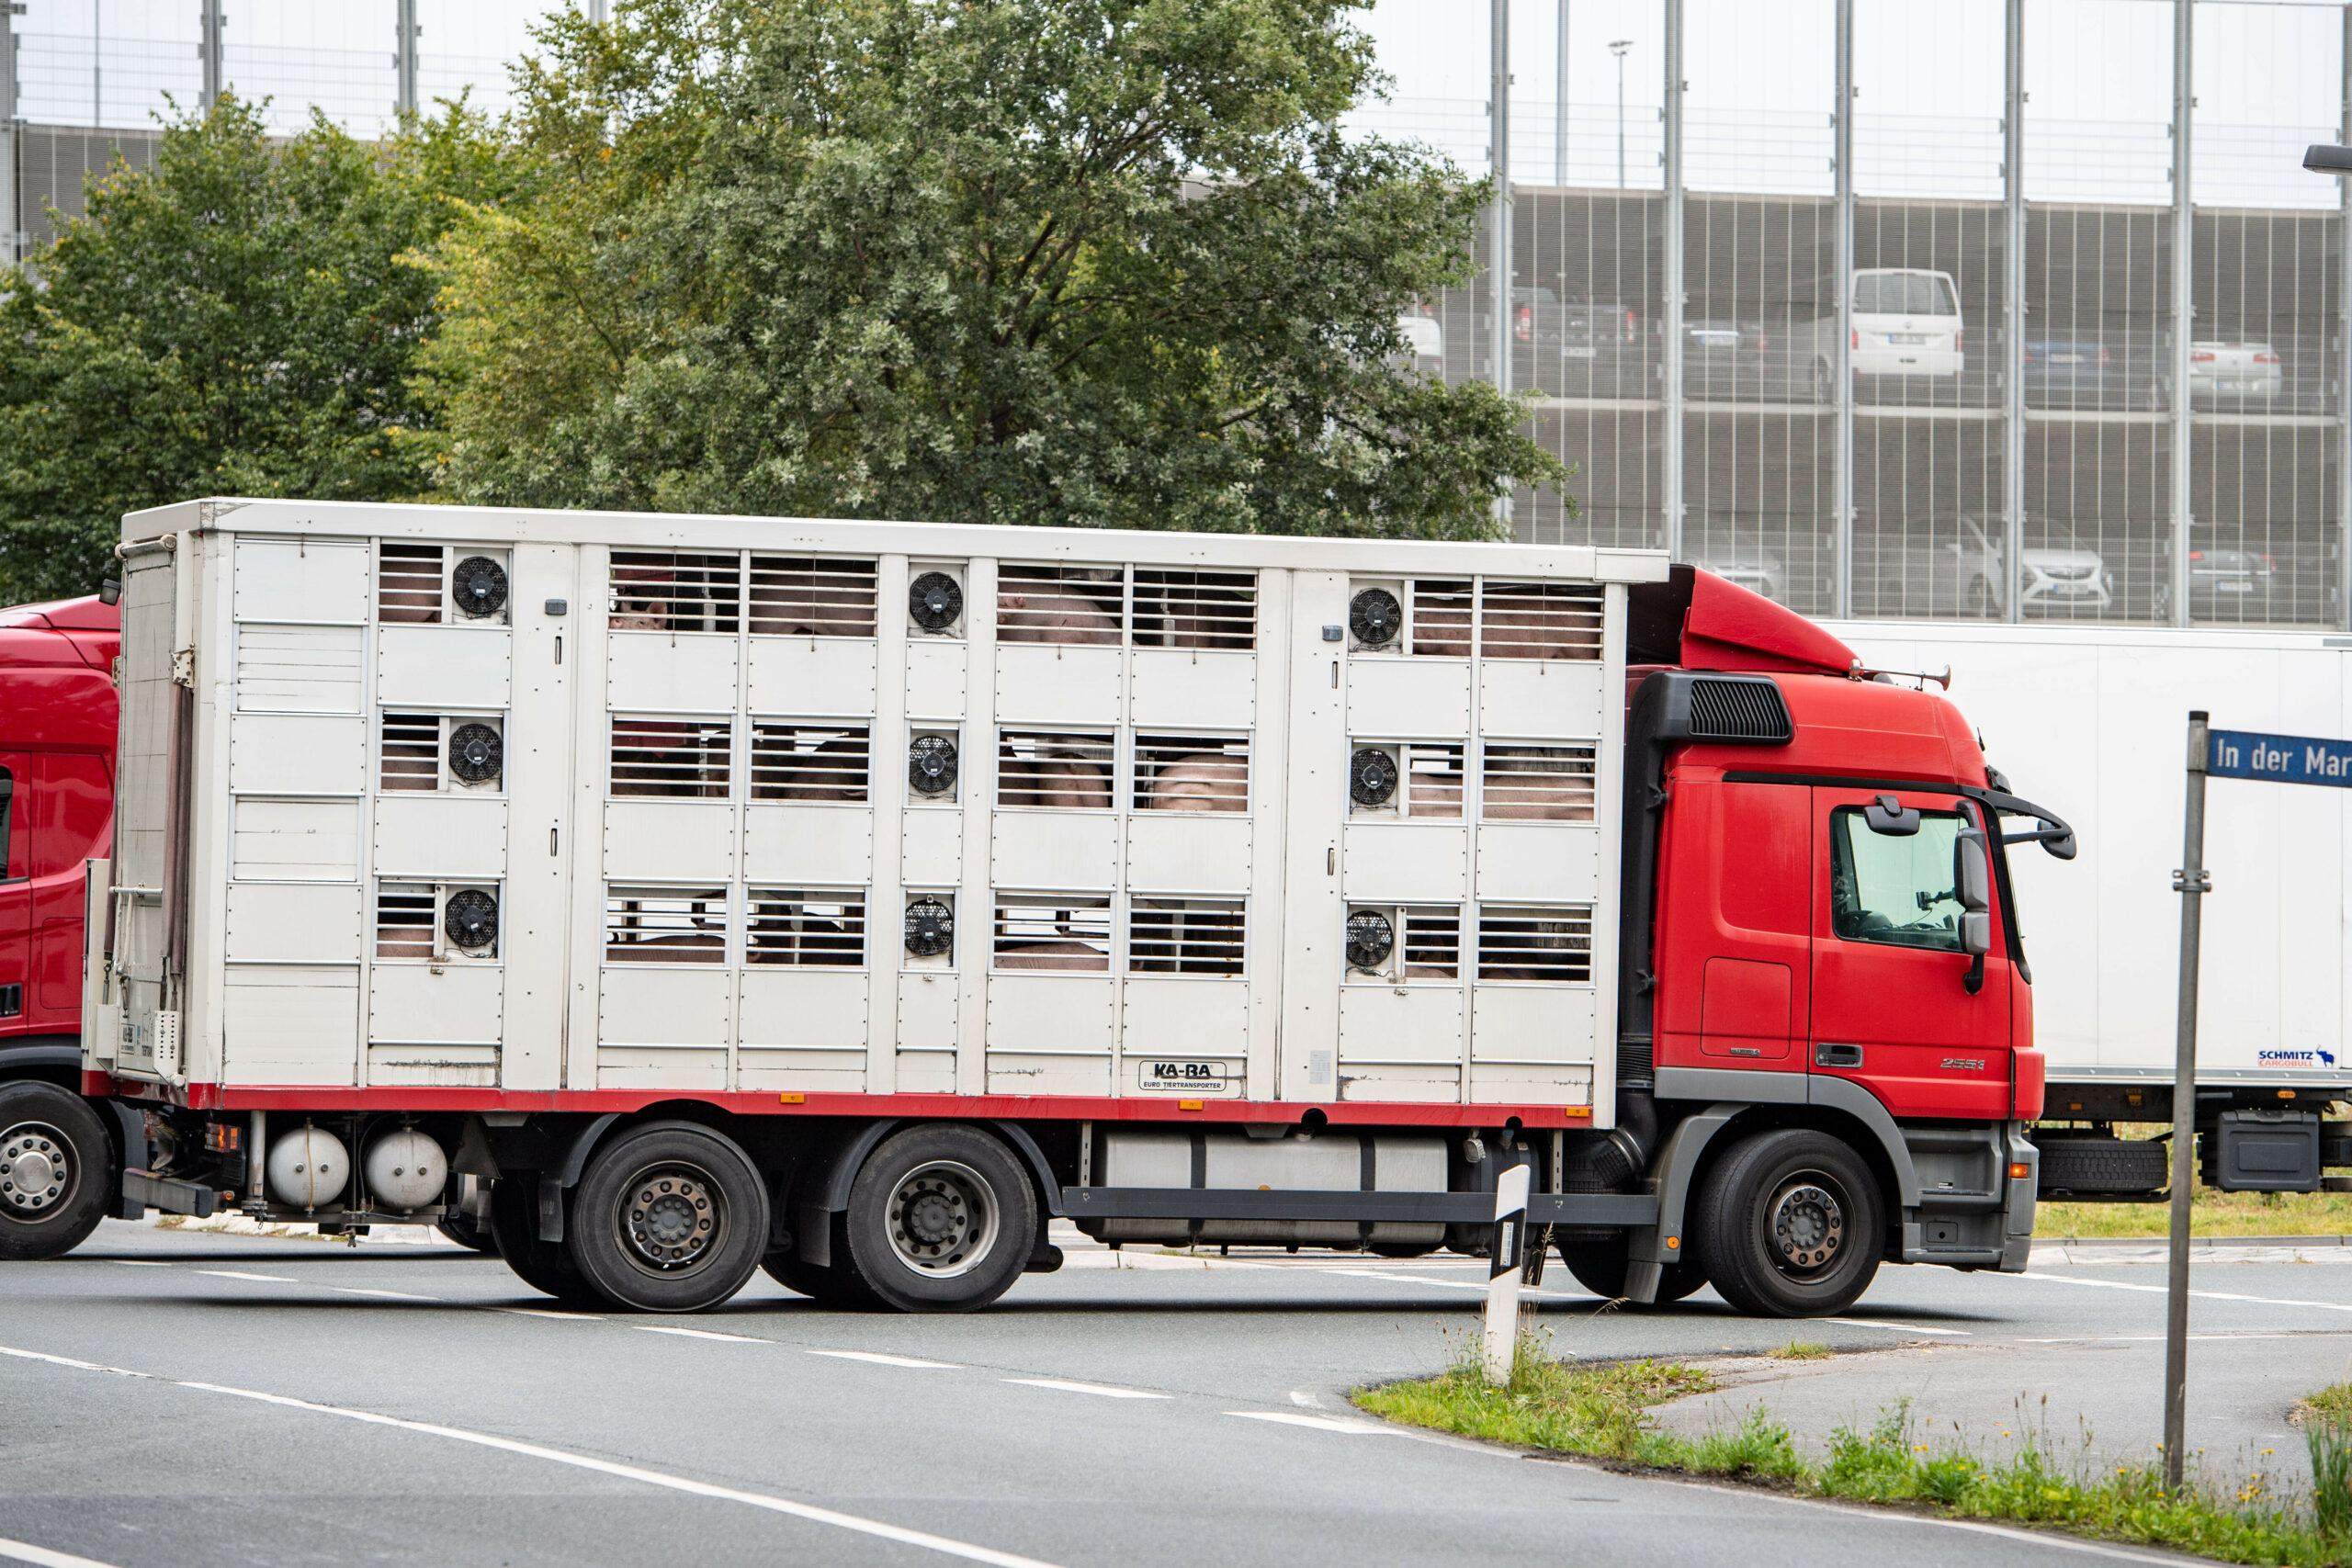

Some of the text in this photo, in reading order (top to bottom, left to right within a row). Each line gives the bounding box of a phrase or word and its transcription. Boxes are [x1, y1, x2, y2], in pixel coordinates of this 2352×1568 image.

[2217, 739, 2352, 777] In der Mar
[2258, 1051, 2313, 1060] SCHMITZ
[1154, 1063, 1211, 1079] KA-BA
[1939, 1058, 1984, 1070] 2551
